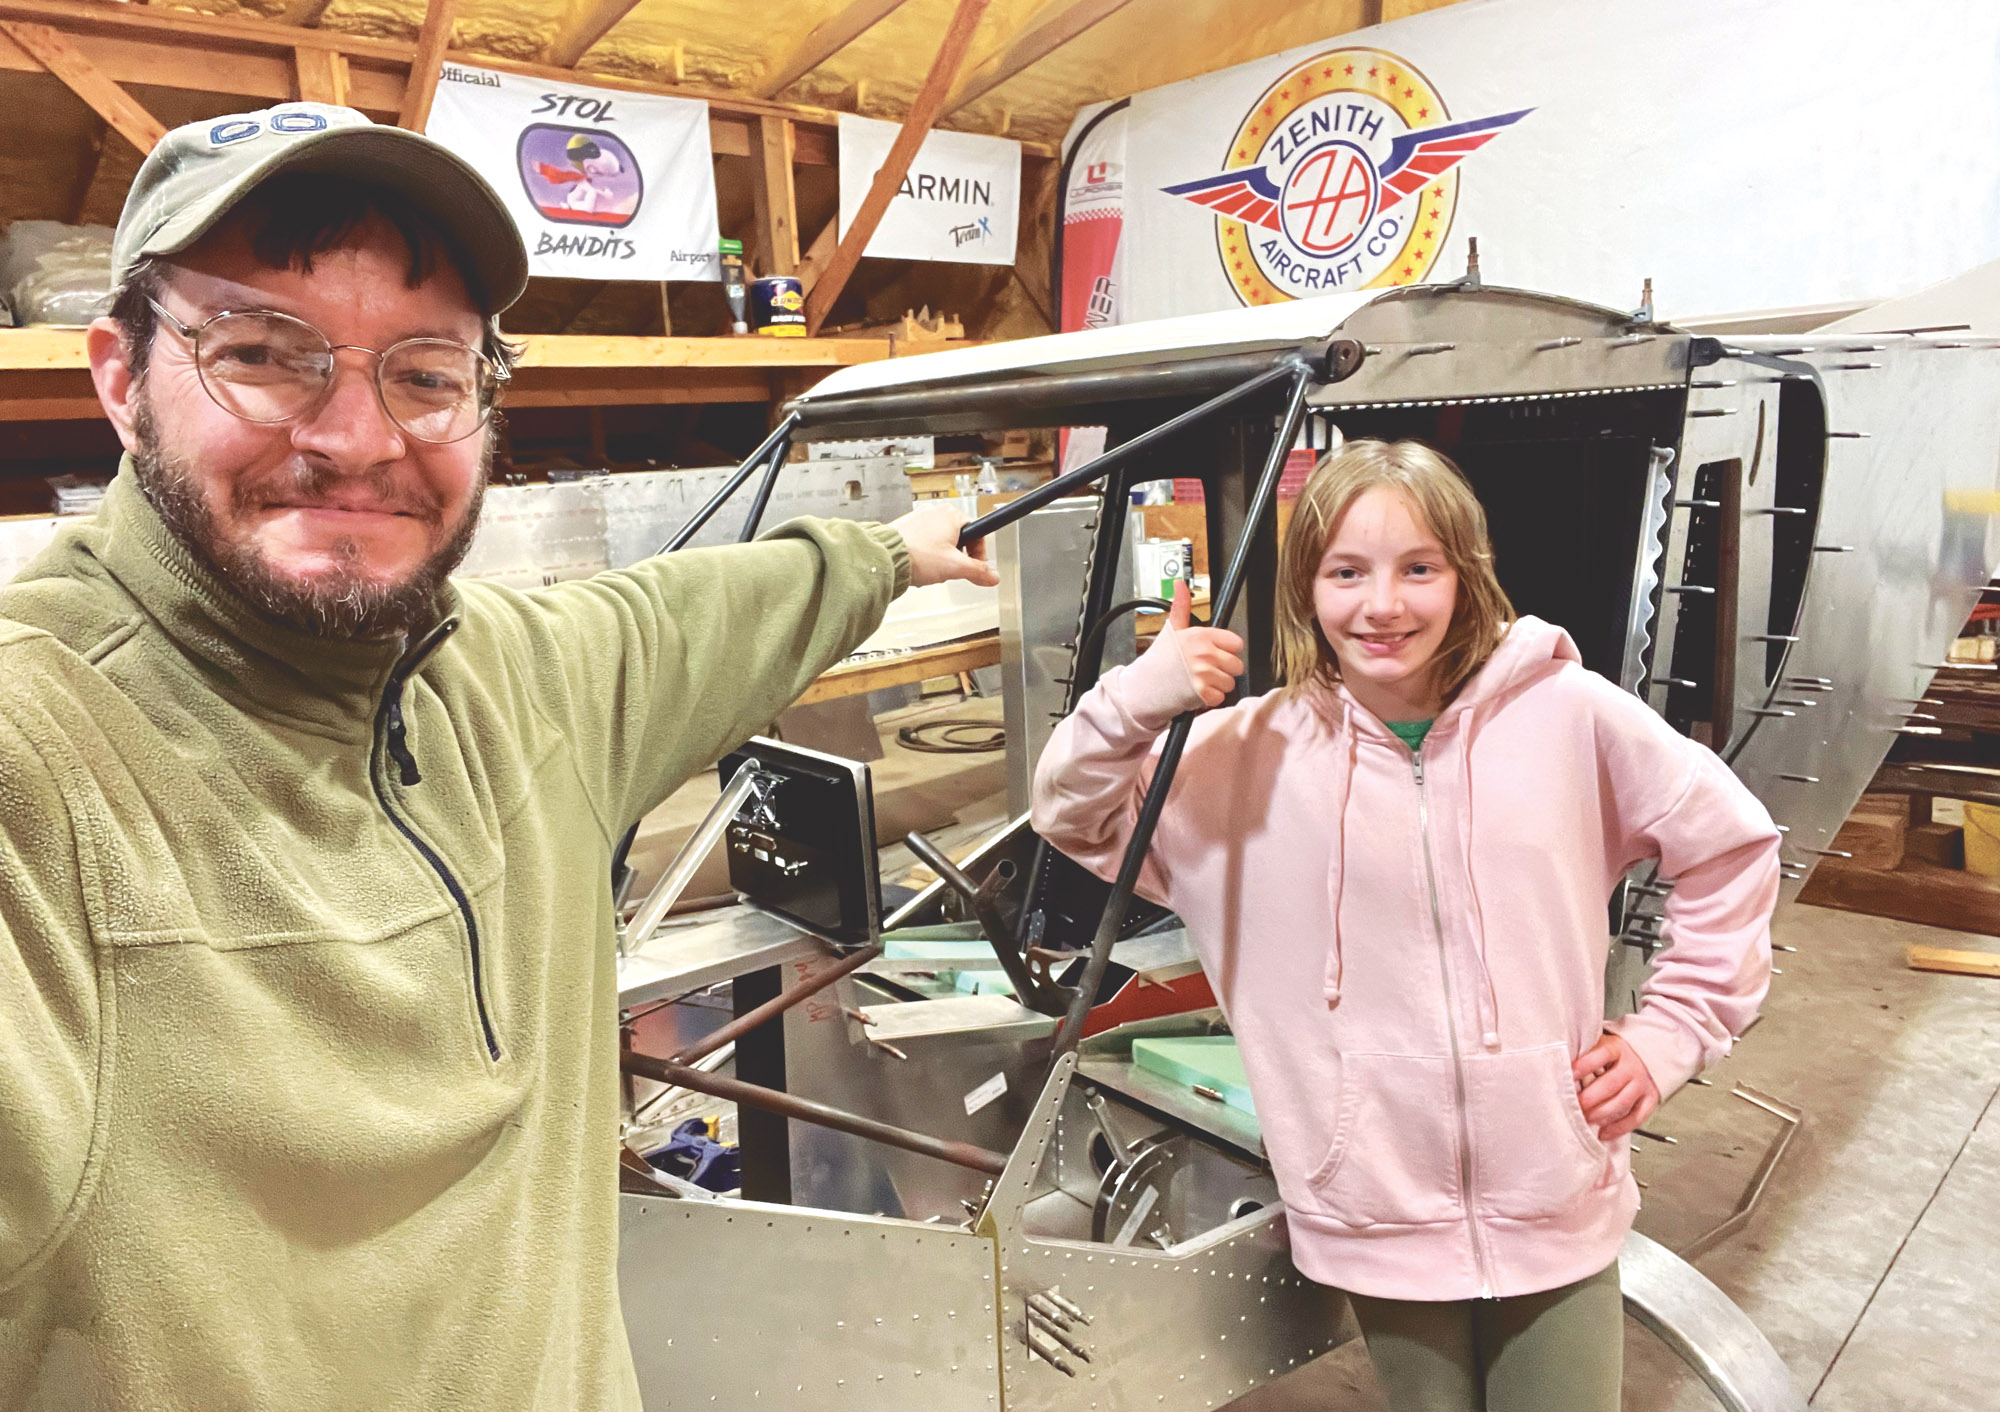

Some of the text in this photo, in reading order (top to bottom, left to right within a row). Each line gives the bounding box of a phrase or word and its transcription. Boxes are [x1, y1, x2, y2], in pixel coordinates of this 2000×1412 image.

[531, 93, 615, 123] STOL
[1270, 104, 1385, 166] ZENITH
[873, 169, 990, 206] ARMIN
[1259, 239, 1363, 289] AIRCRAFT
